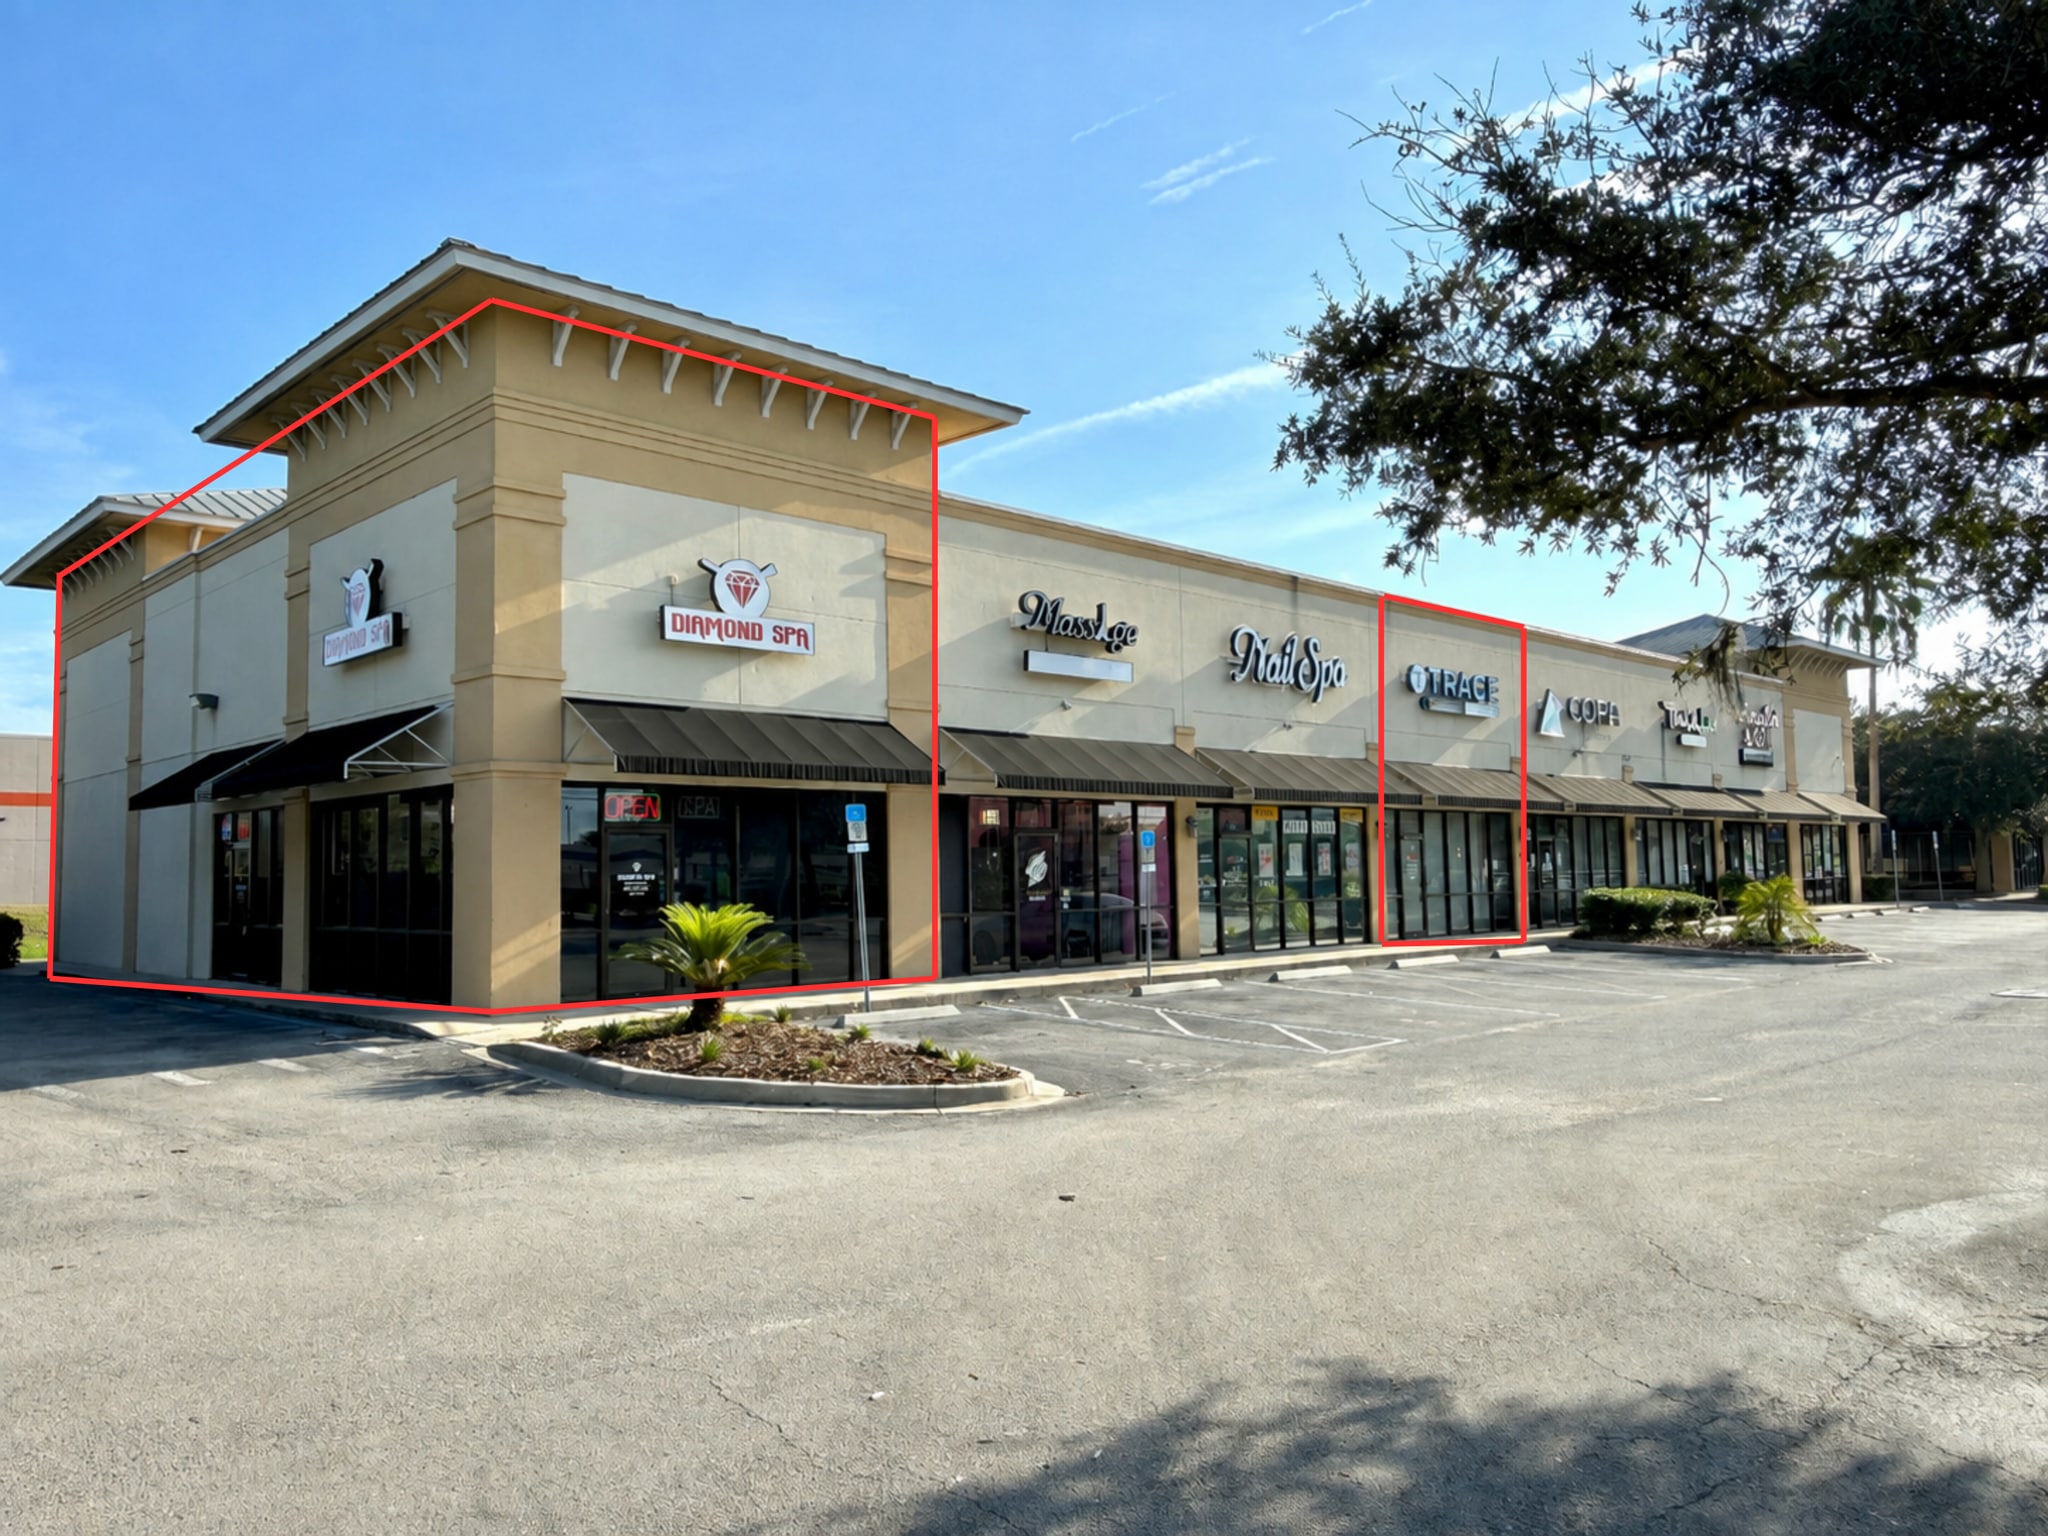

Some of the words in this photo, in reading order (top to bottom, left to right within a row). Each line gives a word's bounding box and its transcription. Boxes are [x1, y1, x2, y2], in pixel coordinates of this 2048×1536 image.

[671, 612, 763, 642] DIAMOND
[772, 624, 810, 651] SPA
[1230, 624, 1298, 684] Nail
[1294, 635, 1348, 704] Spa
[1424, 666, 1499, 706] TRACE
[604, 795, 660, 820] OPEN
